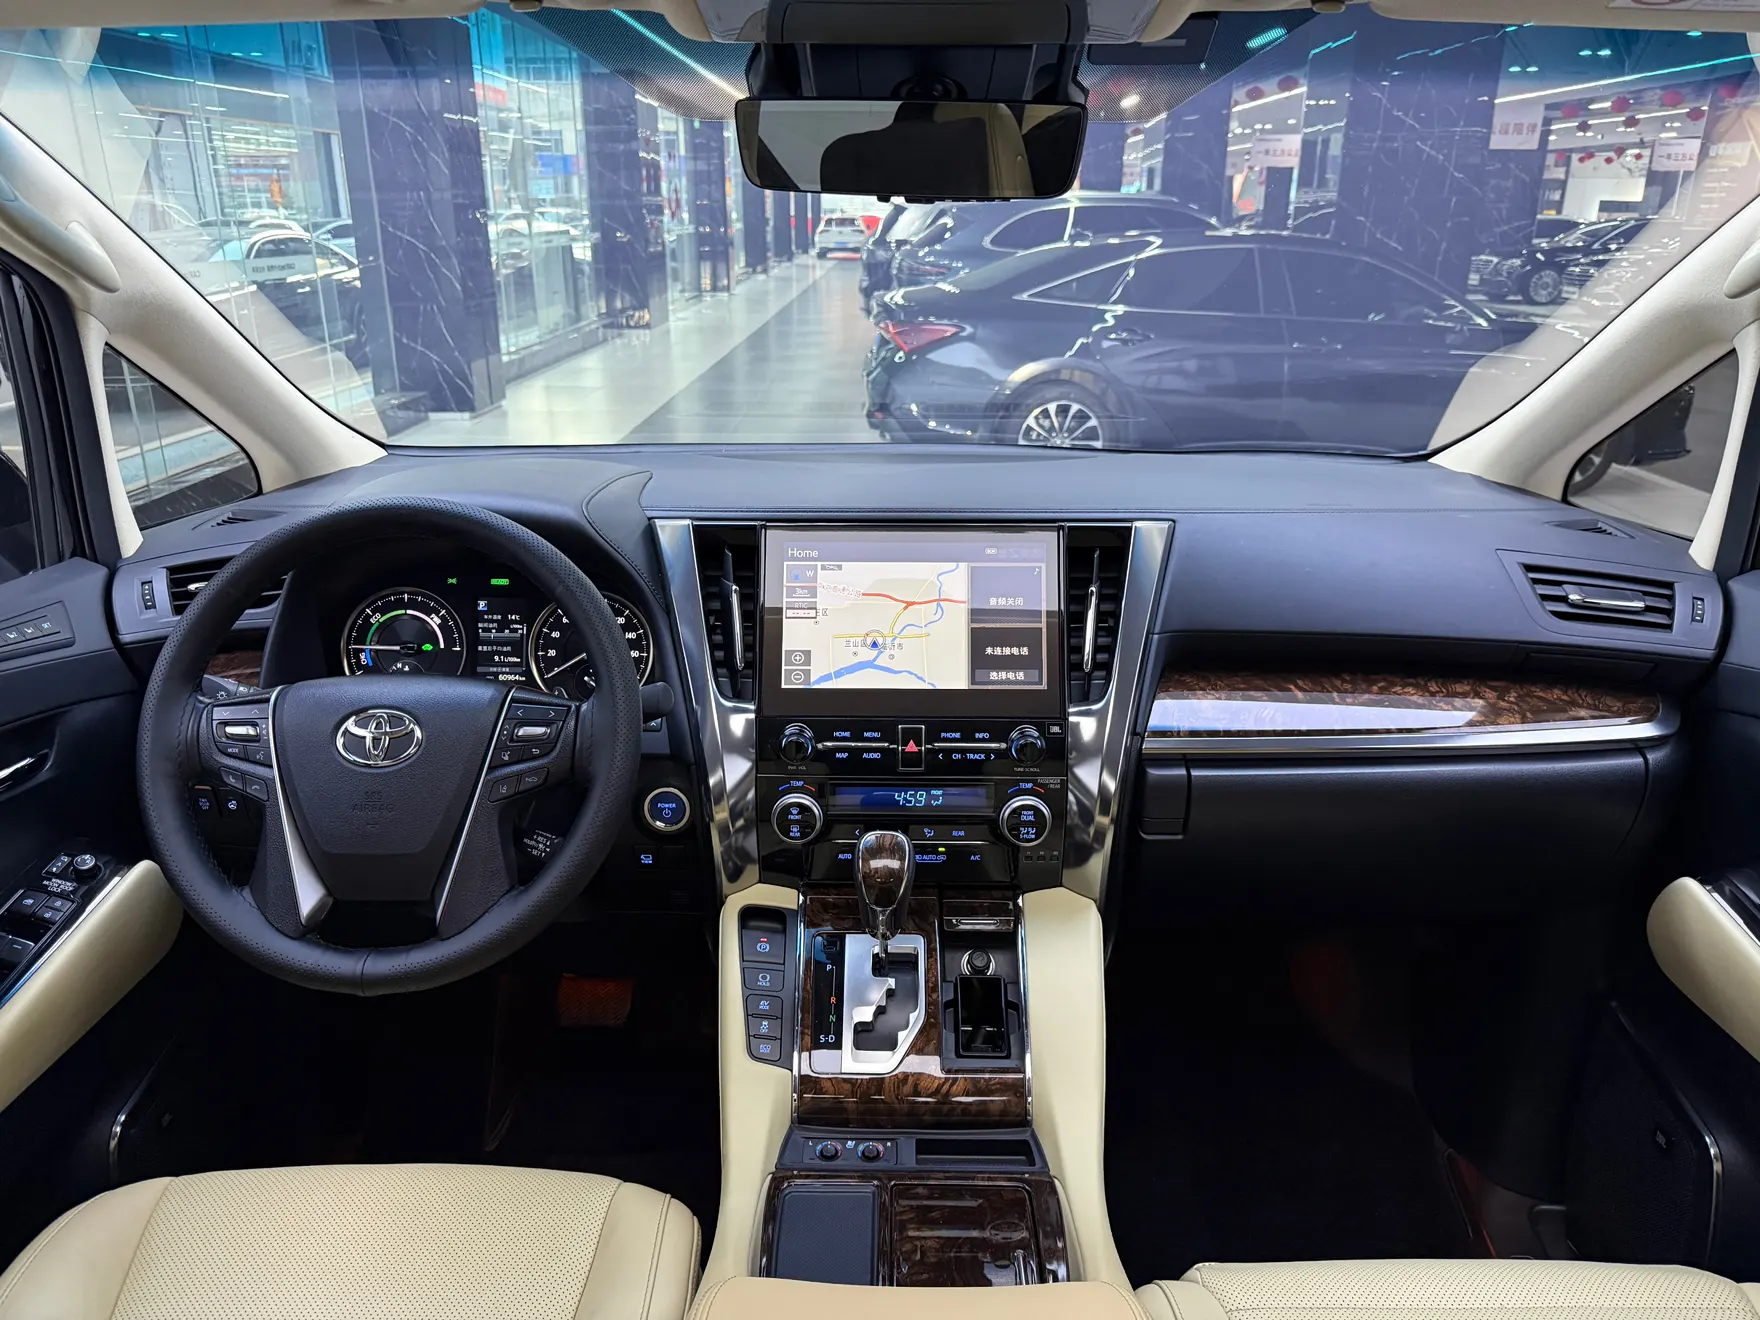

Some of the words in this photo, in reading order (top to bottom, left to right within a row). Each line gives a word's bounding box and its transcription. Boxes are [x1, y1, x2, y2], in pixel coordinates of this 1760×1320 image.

[788, 548, 818, 558] Home
[806, 570, 814, 578] W
[989, 597, 1024, 606] 音频关闭
[370, 612, 382, 624] ECO
[547, 649, 556, 657] 20
[985, 646, 1029, 656] 未连接电话
[989, 671, 1025, 681] 选择电话
[894, 791, 927, 807] 4:59
[826, 964, 832, 972] P
[830, 996, 837, 1004] R
[829, 1014, 836, 1022] N
